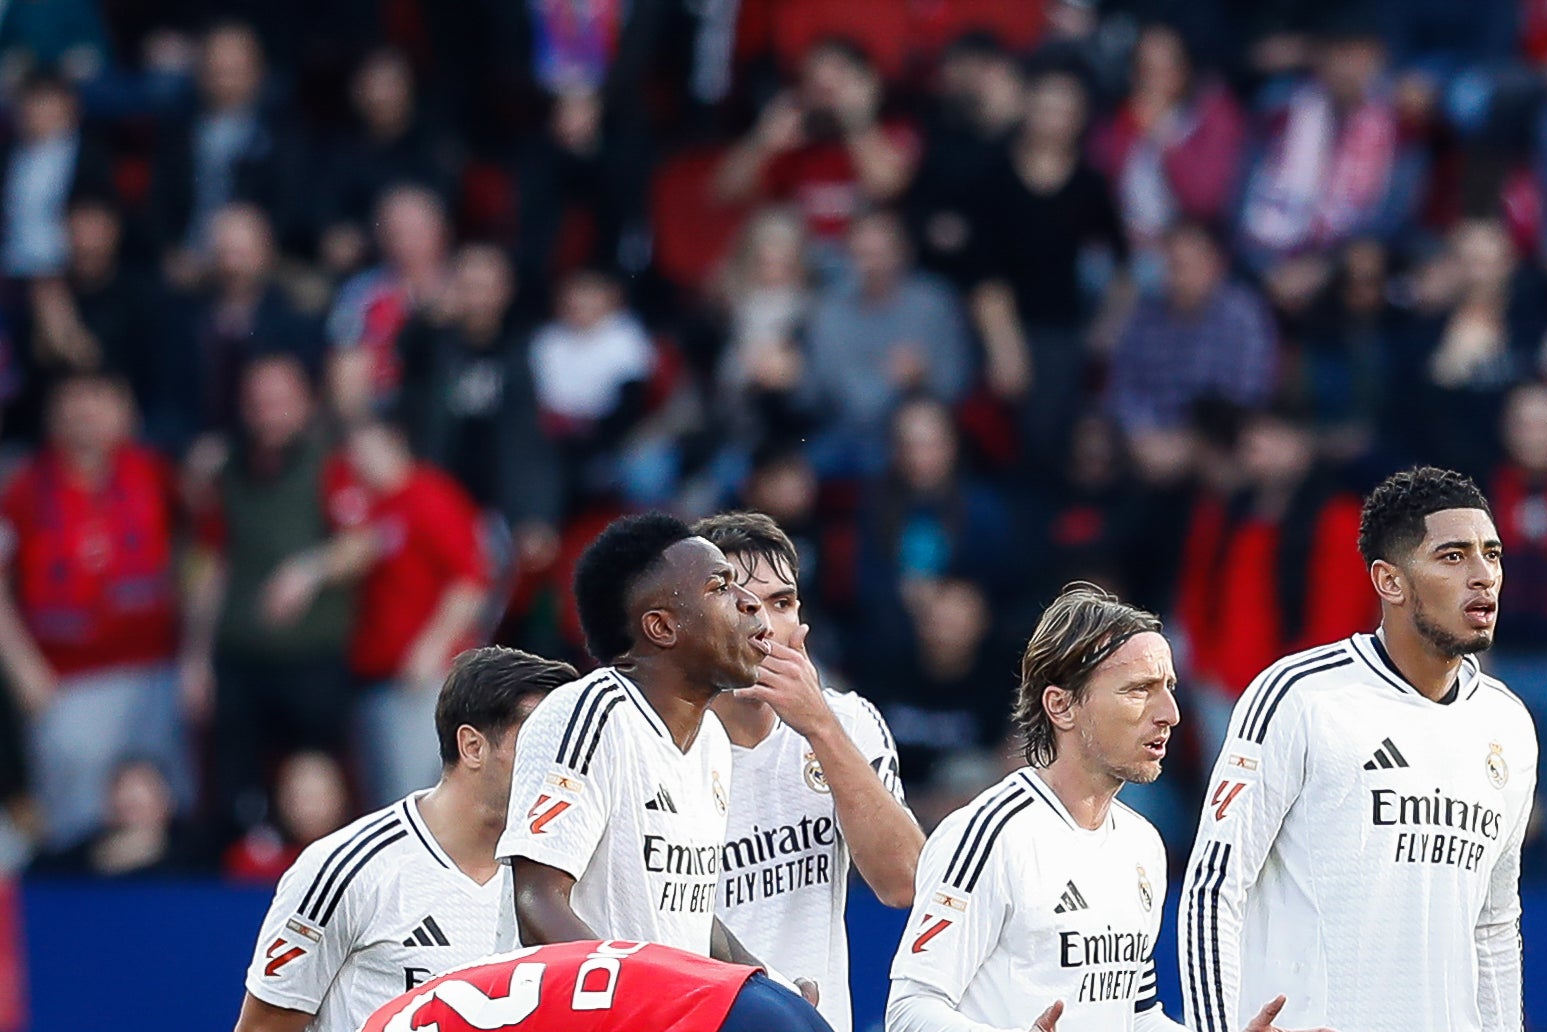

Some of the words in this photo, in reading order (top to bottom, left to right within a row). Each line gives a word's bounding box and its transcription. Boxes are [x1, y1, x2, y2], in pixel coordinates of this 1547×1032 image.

[1371, 787, 1502, 841] Emirates
[660, 881, 687, 912] FLY
[726, 873, 757, 908] FLY
[763, 853, 829, 898] BETTER
